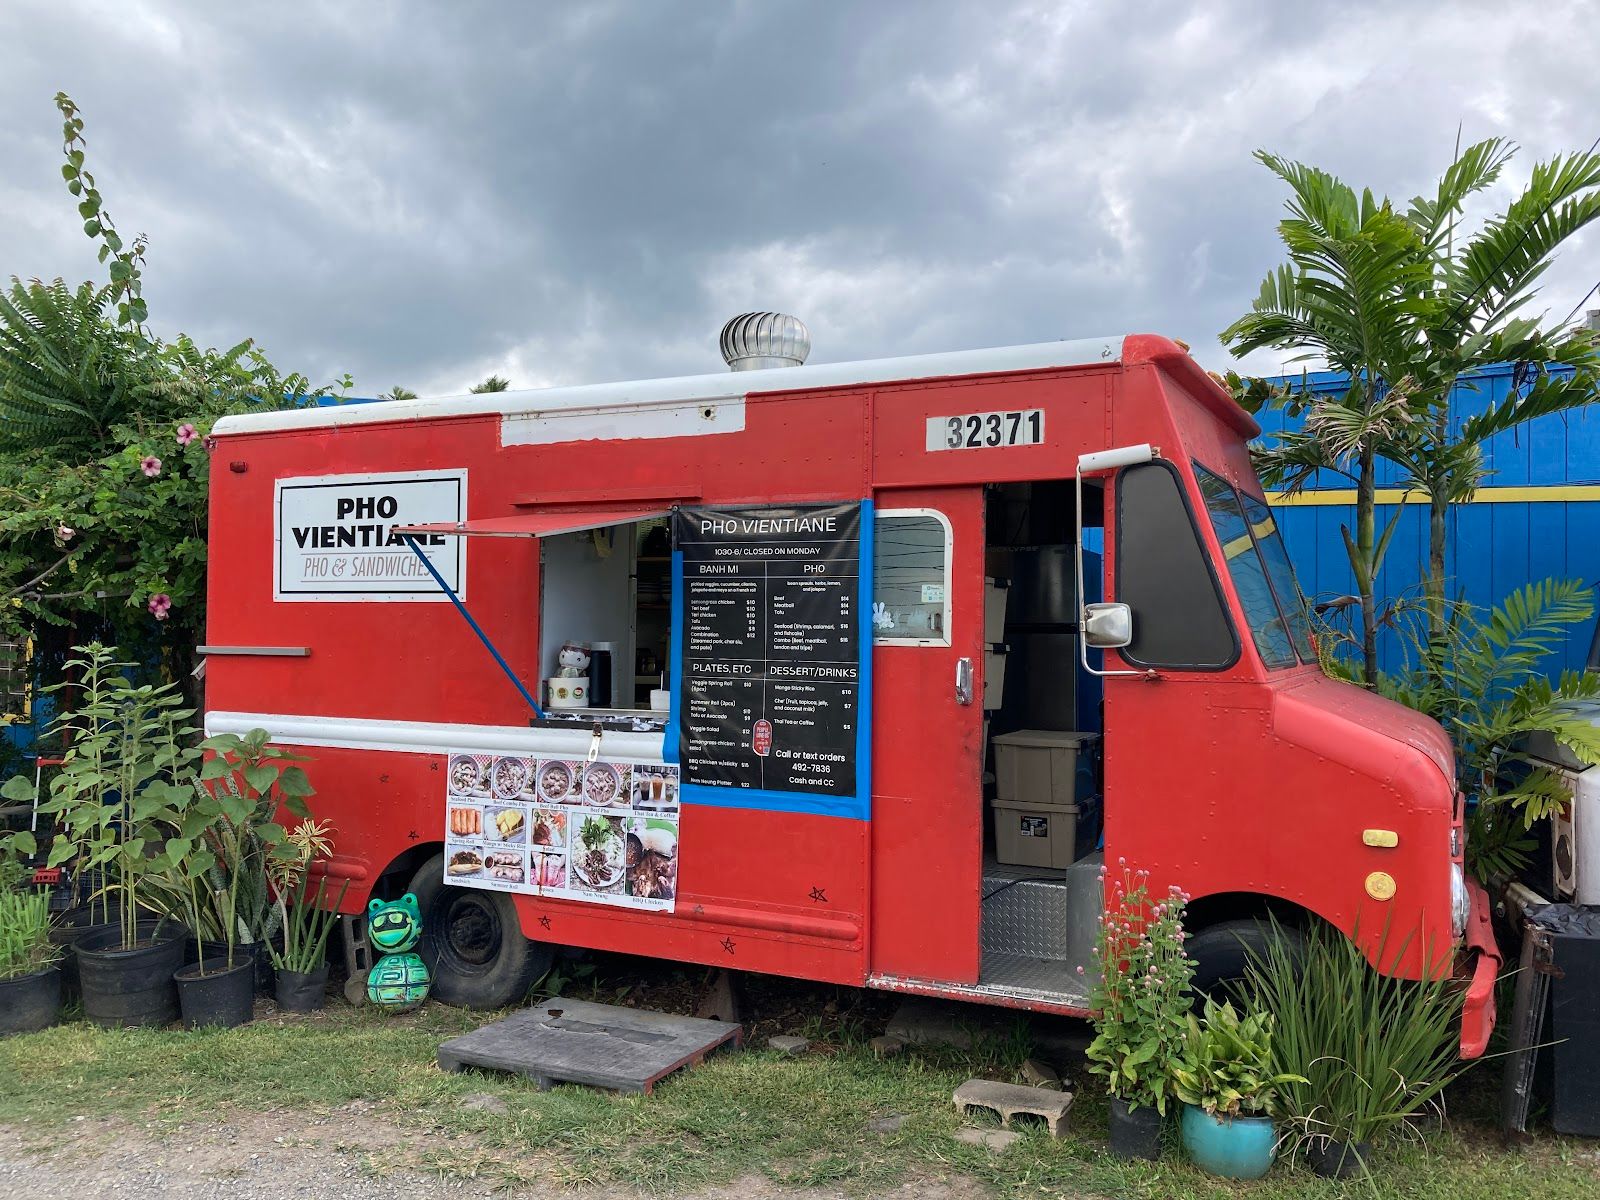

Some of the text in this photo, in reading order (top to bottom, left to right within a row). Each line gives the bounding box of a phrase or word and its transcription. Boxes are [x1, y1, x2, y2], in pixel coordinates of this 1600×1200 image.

[947, 410, 1041, 449] 32371
[336, 496, 398, 520] PHO
[701, 517, 837, 534] PHO VIENTIANE
[714, 548, 743, 556] 1030-6/
[744, 548, 774, 556] CLOSED
[786, 547, 821, 555] MONDAY
[304, 558, 328, 577] PHO
[332, 559, 347, 577] &
[699, 565, 739, 574] BANH MI
[804, 564, 826, 573] PHO
[693, 664, 752, 674] PLATES, ETC
[770, 666, 857, 678] DESSERT/DRINKS
[776, 750, 792, 759] Call
[802, 751, 818, 760] text
[818, 752, 846, 762] orders
[792, 762, 831, 774] 492-7836
[789, 776, 835, 788] Cash and CC
